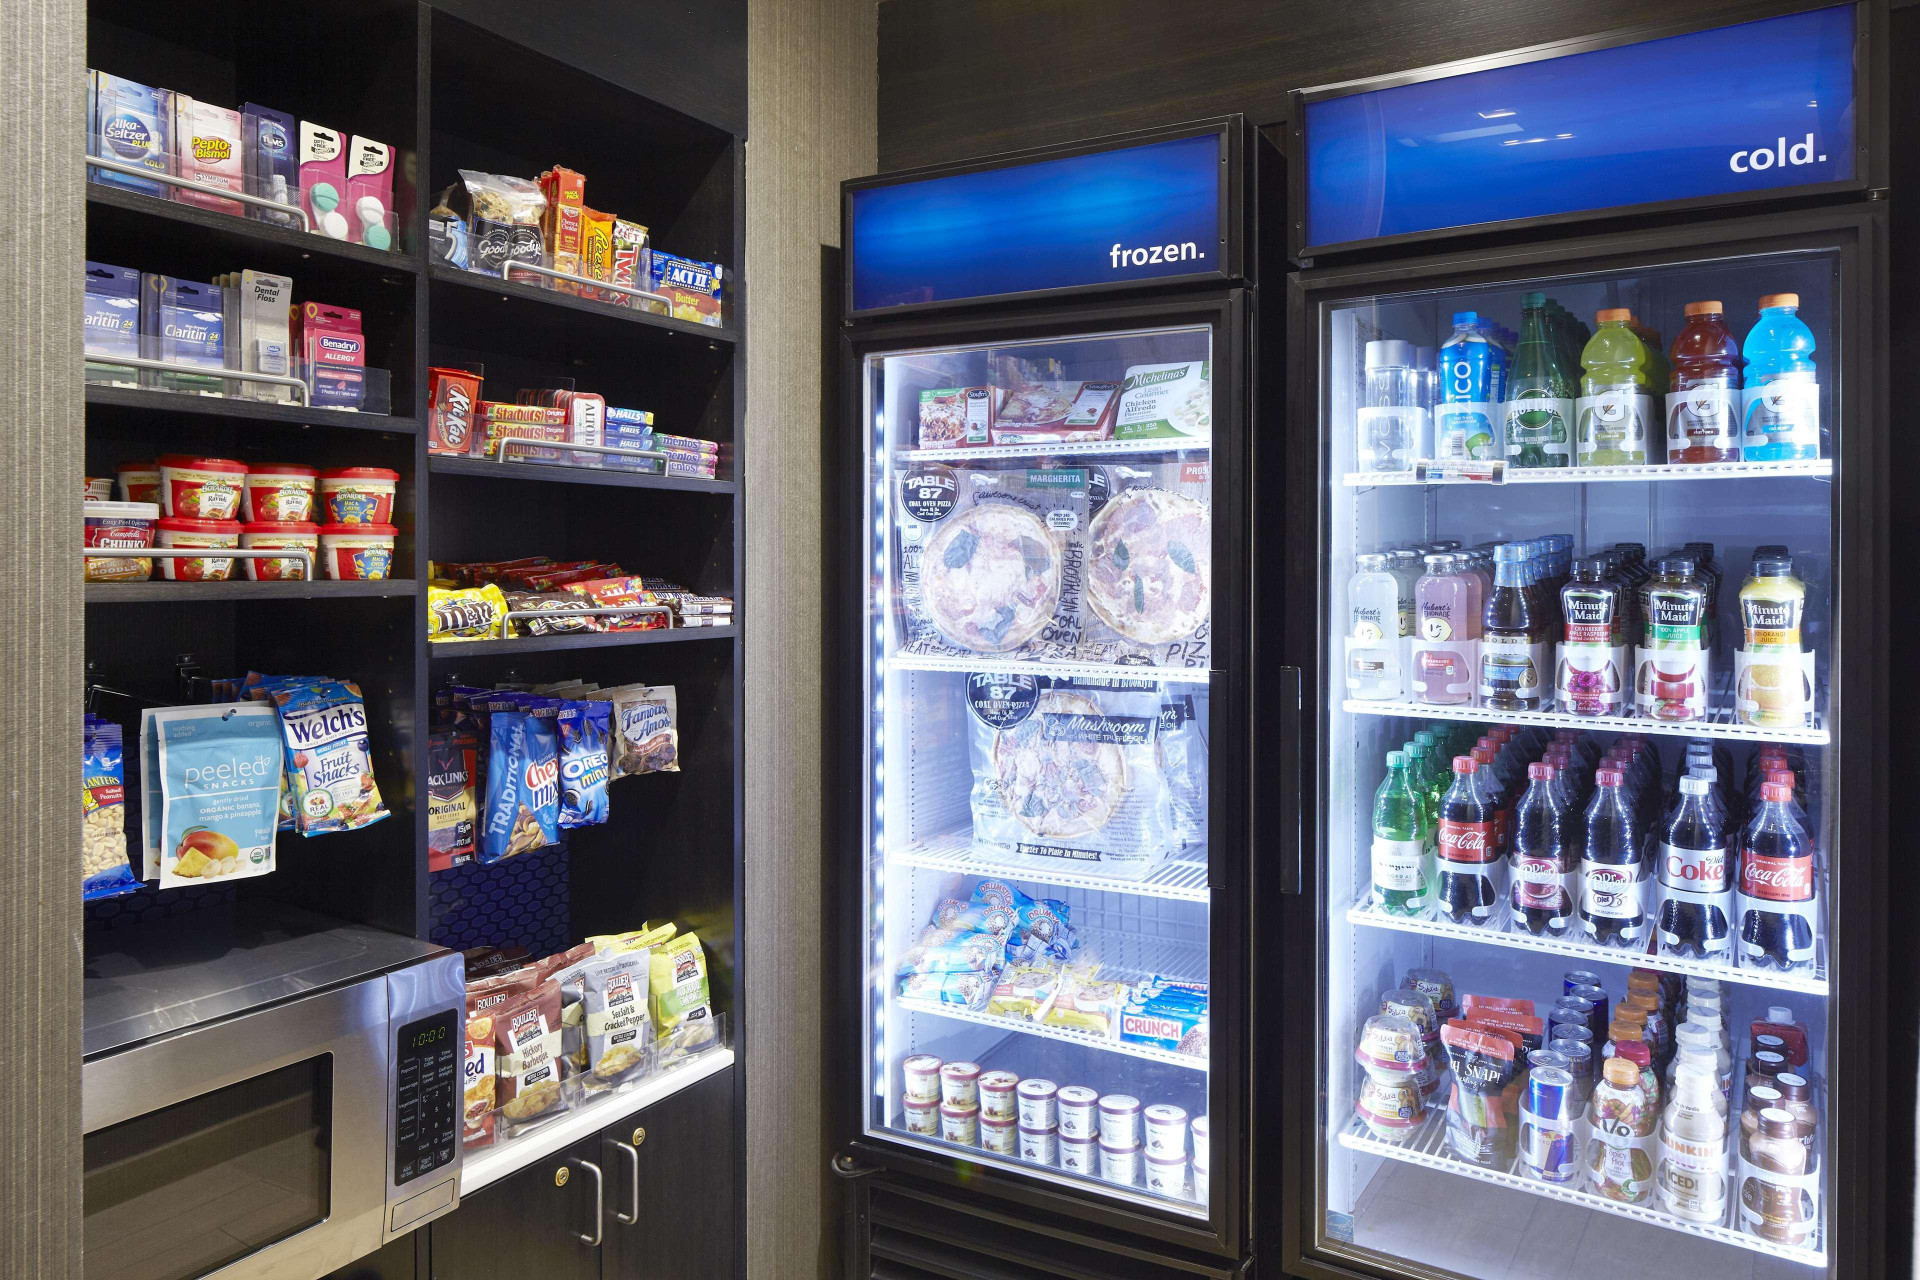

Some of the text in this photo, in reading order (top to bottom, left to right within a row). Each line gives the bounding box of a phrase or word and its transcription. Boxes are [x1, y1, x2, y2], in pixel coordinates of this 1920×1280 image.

[110, 118, 141, 130] Alka-
[106, 127, 148, 139] Seltzer
[192, 137, 231, 149] Pepto-
[262, 135, 285, 148] TUMS
[196, 148, 231, 160] Bismol
[1730, 132, 1827, 173] cold.
[1110, 241, 1205, 268] frozen.
[670, 267, 692, 283] ACT
[254, 285, 280, 297] Dental
[257, 293, 276, 303] Floss
[675, 292, 700, 306] Butter
[164, 324, 207, 341] Claritin
[323, 338, 357, 352] Benadryl
[324, 352, 356, 363] ALLERGY
[1128, 368, 1186, 389] Michelina's
[1125, 399, 1157, 408] Chicken
[1125, 405, 1157, 413] Alfredo
[495, 407, 546, 421] Starburst
[615, 410, 642, 421] HALLS
[495, 424, 545, 438] Starburst
[620, 440, 640, 448] HALLS
[662, 437, 699, 449] mentos
[905, 475, 955, 491] TABLE
[1030, 474, 1081, 483] MARGHERITA
[919, 488, 943, 499] 87
[100, 538, 146, 548] CHUNKY
[1569, 600, 1608, 610] Minute
[1655, 600, 1695, 611] Minute
[1748, 604, 1790, 615] Minute
[1573, 609, 1604, 620] Maid
[1660, 611, 1691, 621] Maid
[1752, 614, 1786, 625] Maid
[972, 673, 1032, 691] TABLE
[989, 687, 1017, 699] 87
[248, 720, 272, 728] organic
[620, 703, 668, 733] Famous
[1066, 715, 1146, 734] Mushroom
[289, 707, 365, 744] Welch's
[634, 718, 672, 742] Amos
[320, 751, 352, 773] Fruit
[562, 753, 609, 780] OREO
[184, 756, 267, 790] peeled
[313, 762, 360, 789] Snacks
[488, 722, 525, 835] TRADITIONAL
[203, 778, 255, 790] SNACKS
[212, 797, 233, 806] gently
[309, 804, 329, 812] REAL
[199, 805, 235, 814] ORGANIC
[199, 813, 224, 823] mango
[230, 809, 262, 821] pineapple
[428, 802, 467, 816] ORIGINAL
[1438, 827, 1488, 850] Coca-Cola
[1532, 863, 1546, 873] Dr
[1666, 856, 1725, 881] Coke
[1744, 862, 1807, 888] Coca-Cola
[1602, 872, 1617, 882] Dr
[611, 1009, 622, 1019] Sea
[621, 1007, 631, 1018] Salt
[604, 1013, 646, 1031] Cracked Pepper
[1124, 1017, 1180, 1039] CRUNCH
[412, 1026, 446, 1048] 10:00
[521, 1042, 544, 1059] Hickory
[522, 1051, 549, 1071] Barbeque
[1464, 1062, 1502, 1084] SNAP!
[1667, 1168, 1695, 1190] ICED
